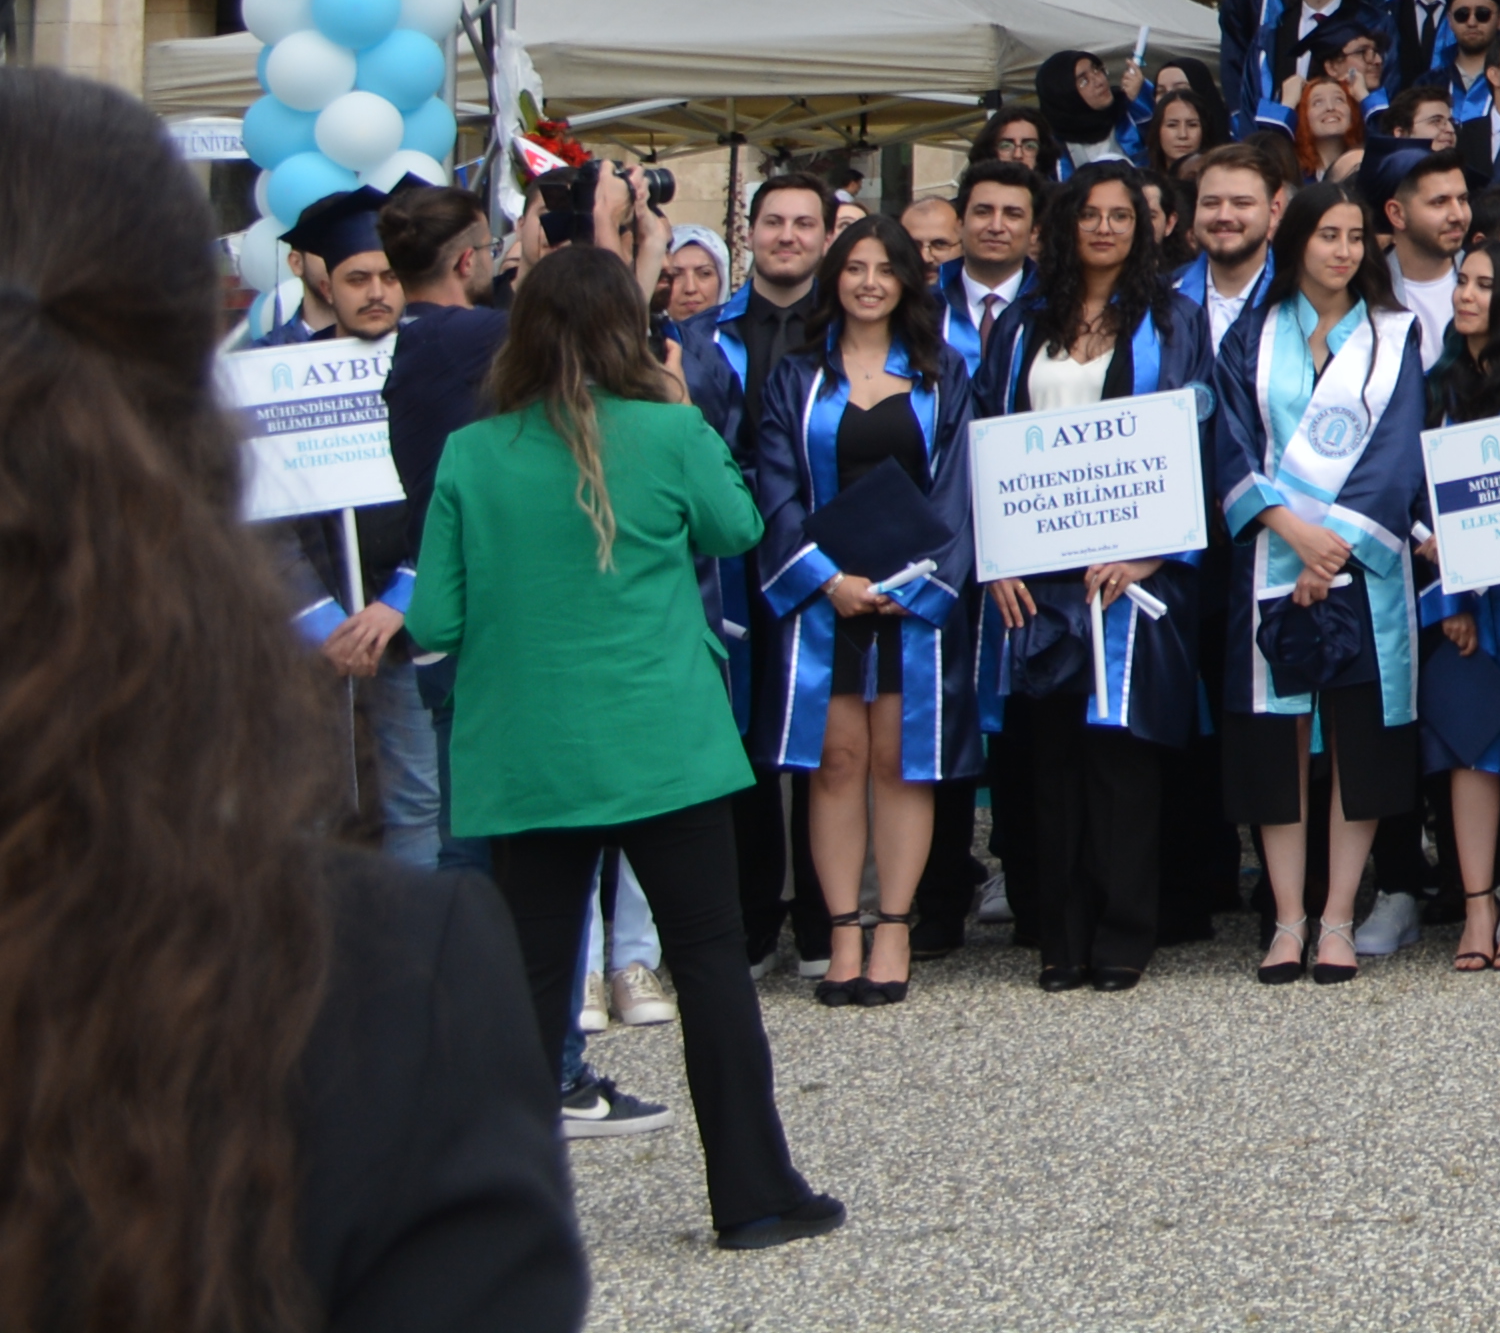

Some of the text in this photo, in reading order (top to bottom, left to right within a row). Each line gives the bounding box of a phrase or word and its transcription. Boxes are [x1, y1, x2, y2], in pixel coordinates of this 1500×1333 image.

[303, 350, 392, 386] AYBÜ
[257, 397, 354, 420] MÜHENDİSLİK
[356, 394, 377, 408] VE
[267, 407, 389, 433] BİLİMLERİ FAKÜLT
[296, 431, 389, 452] BİLGİSAYAR
[1052, 412, 1137, 447] AYBÜ
[283, 445, 392, 471] MÜHENDİSLİ
[998, 456, 1168, 494] MÜHENDİSLİK VE
[1003, 475, 1166, 517] DOĞA BİLİMLERİ
[1037, 503, 1139, 534] FAKÜLTESİ
